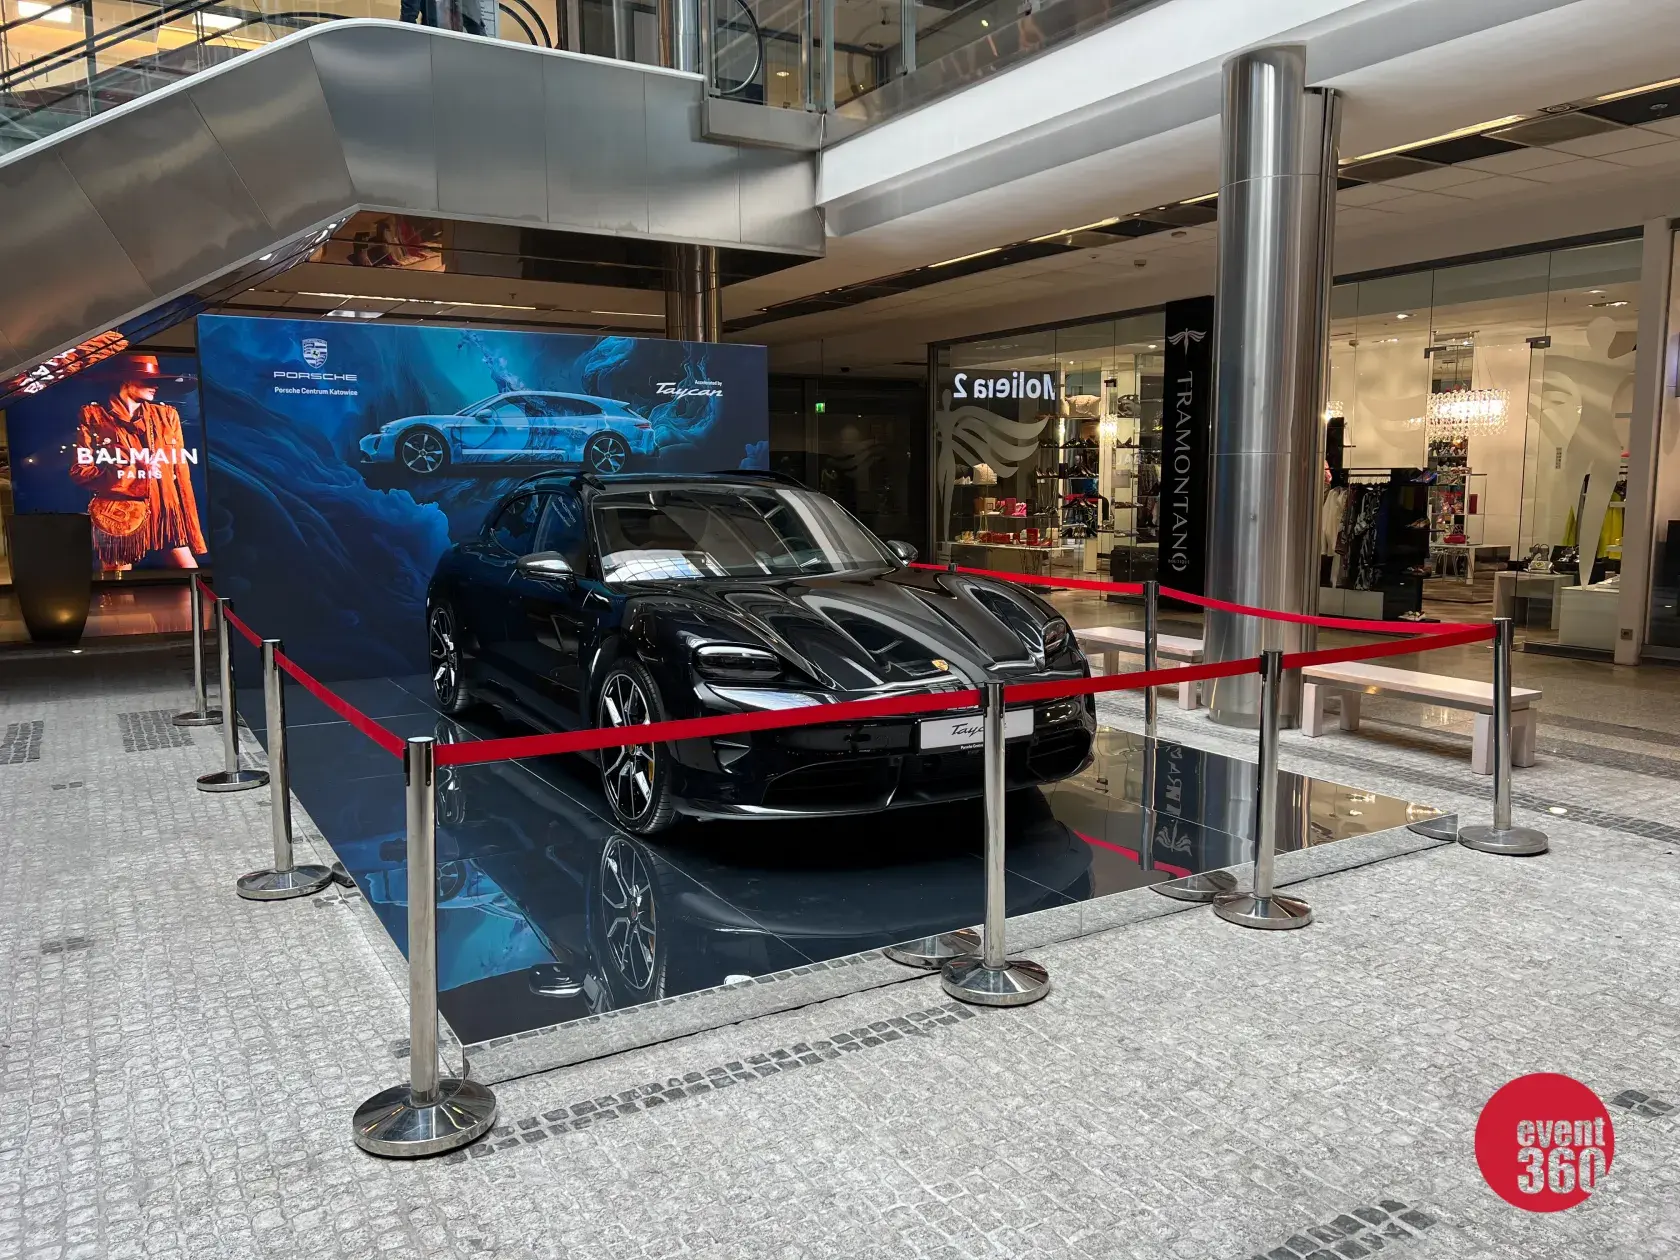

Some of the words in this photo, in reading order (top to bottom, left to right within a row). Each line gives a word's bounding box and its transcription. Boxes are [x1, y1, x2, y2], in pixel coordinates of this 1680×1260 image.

[273, 371, 358, 381] PORSCHE
[274, 386, 300, 394] Porsche
[301, 387, 329, 395] Centrum
[329, 388, 358, 396] Katowice
[656, 382, 723, 399] Taycan
[76, 447, 198, 465] BALMAIN
[117, 470, 162, 479] PARIS
[1171, 371, 1193, 571] TRAMONTANO
